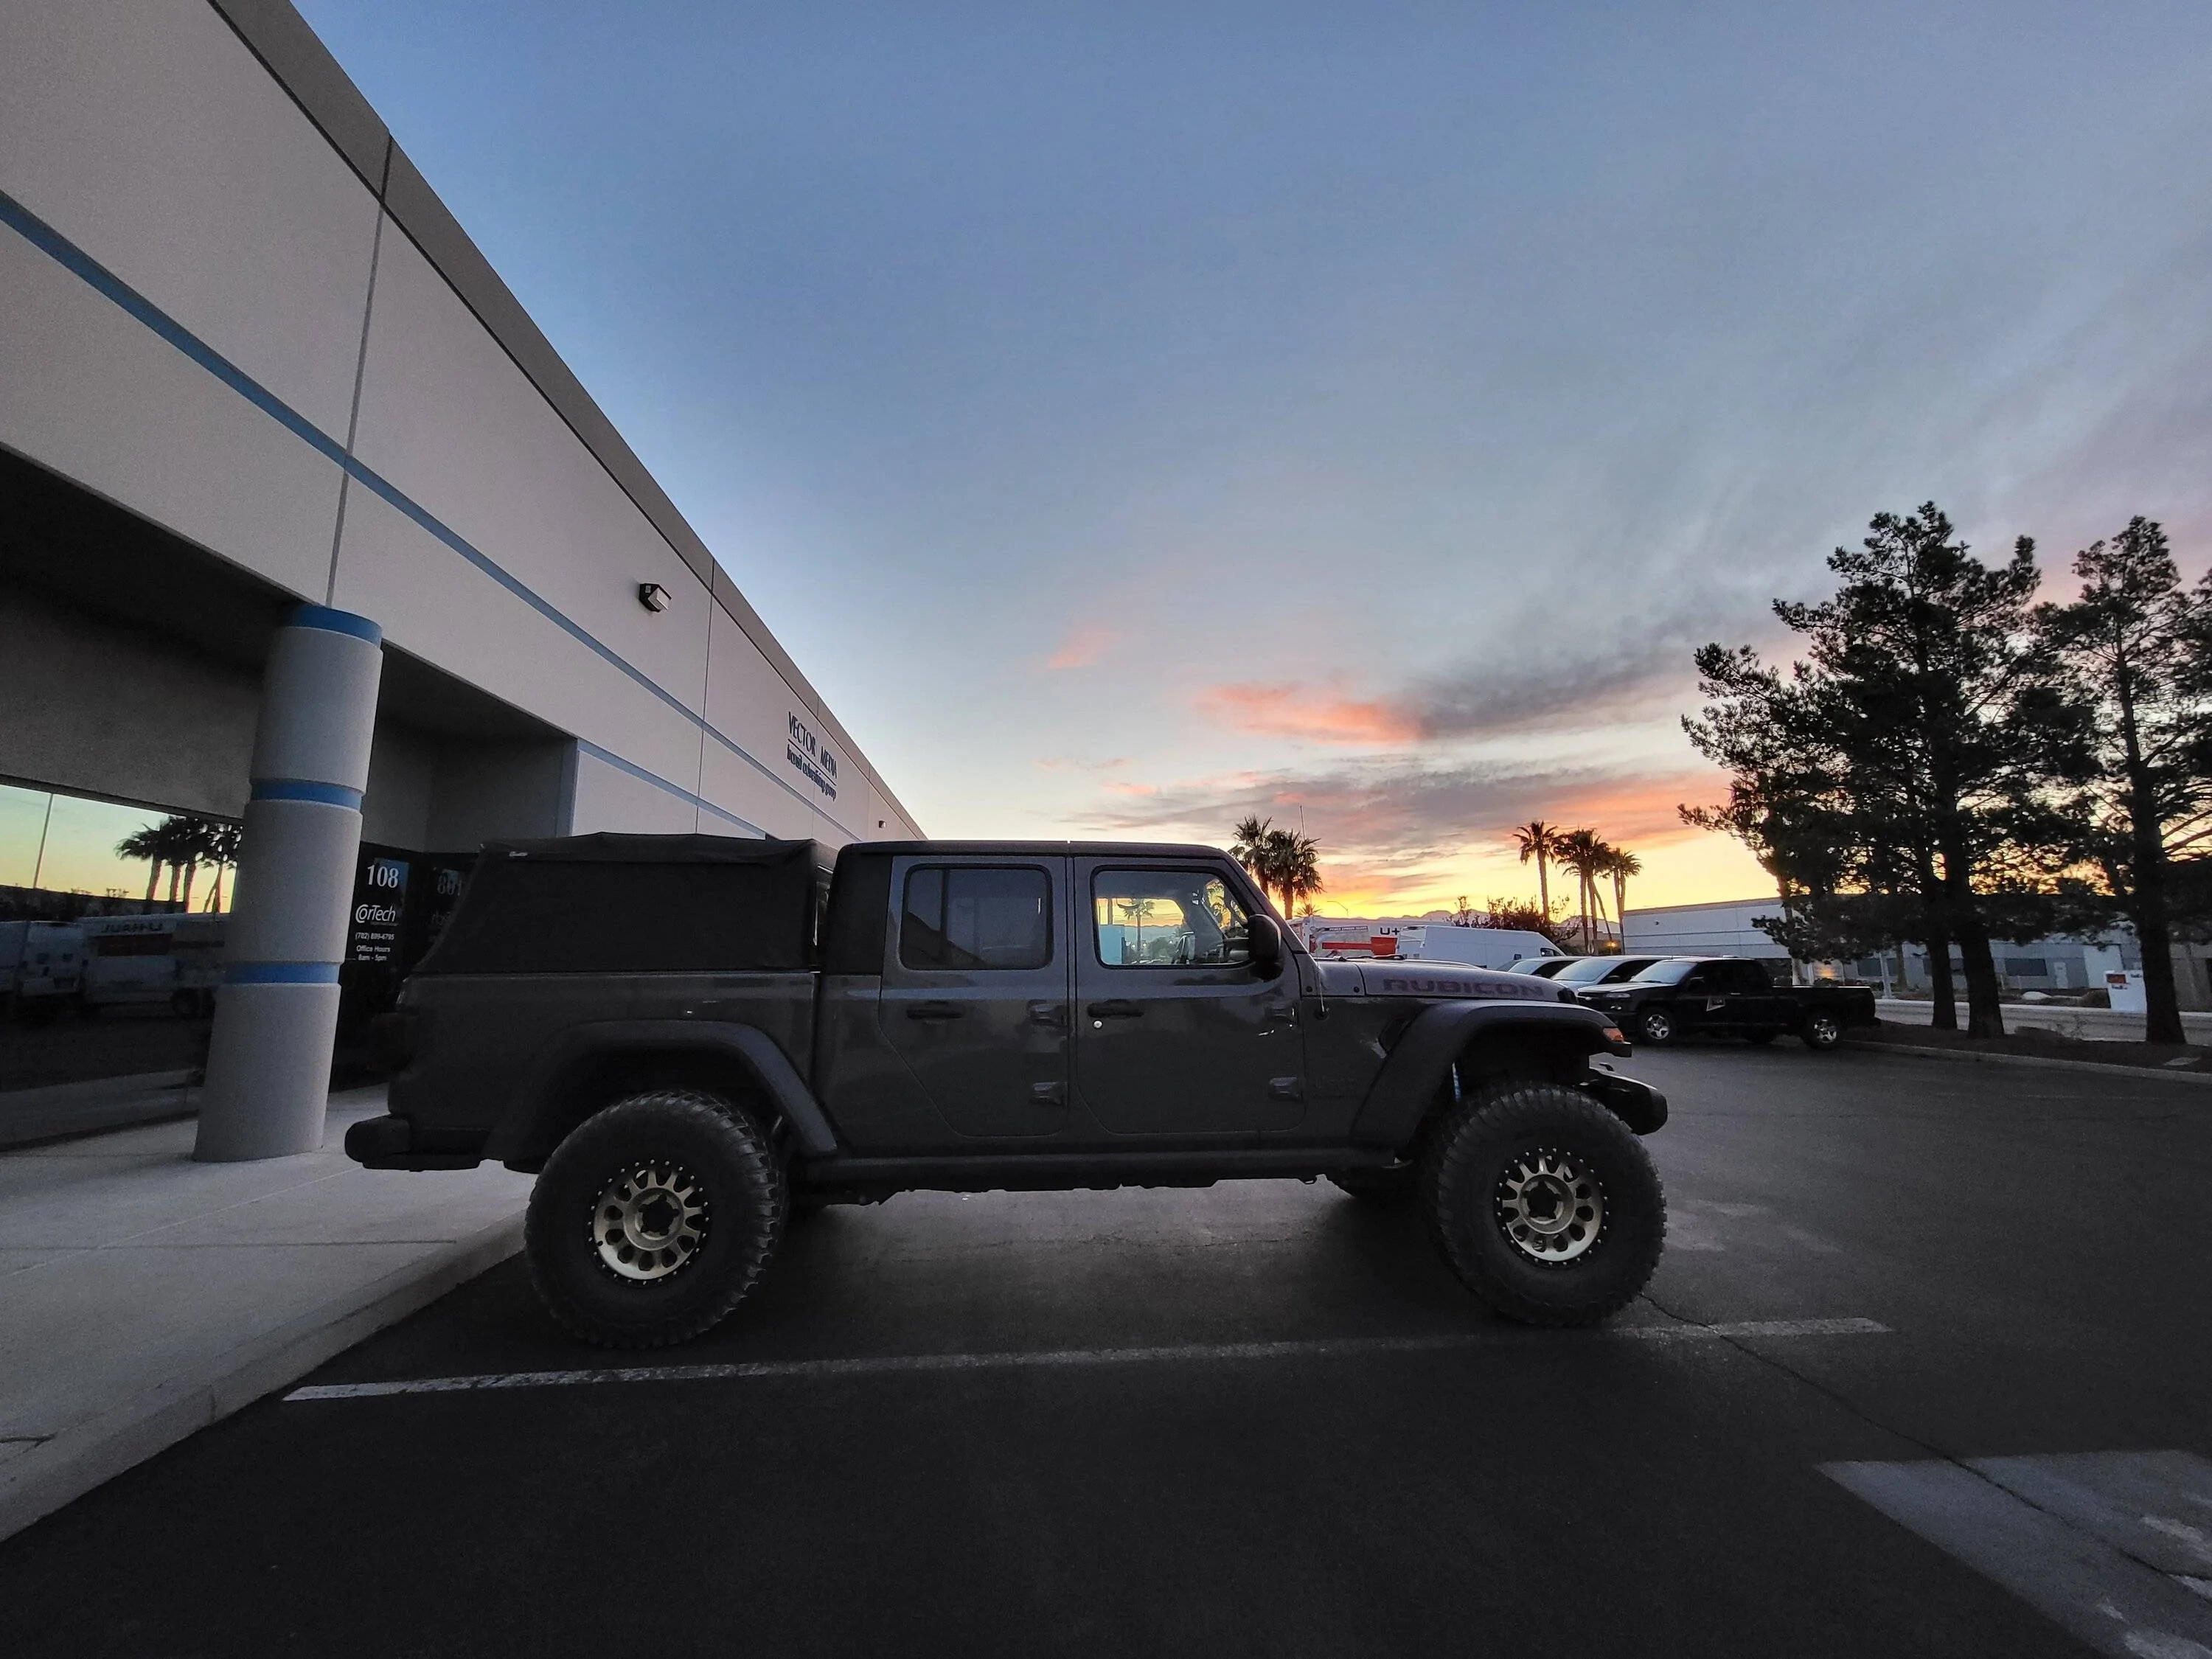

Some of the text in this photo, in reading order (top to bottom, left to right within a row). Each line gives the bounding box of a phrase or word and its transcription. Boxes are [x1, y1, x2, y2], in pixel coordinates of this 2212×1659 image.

[788, 712, 838, 779] VECTOR MEDIA
[367, 865, 399, 888] 108
[355, 904, 396, 923] CorTech
[1383, 978, 1544, 996] RUBICON
